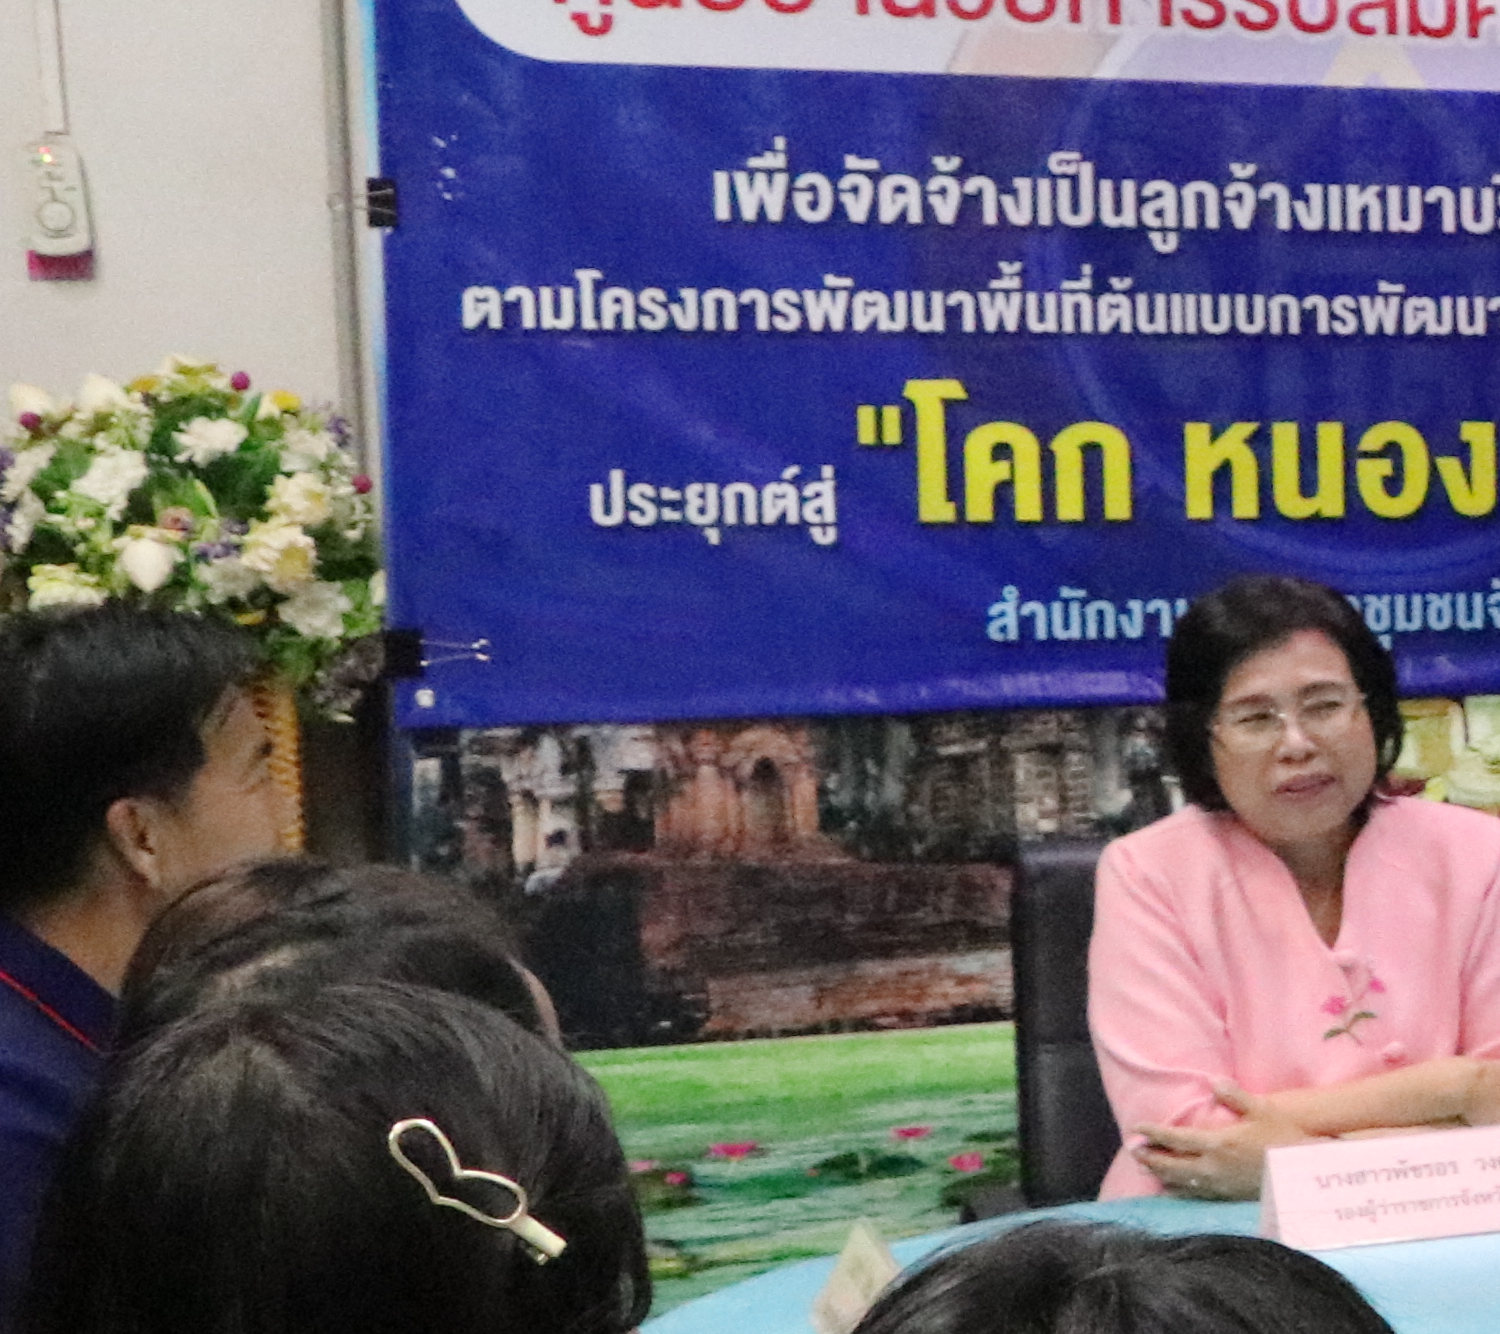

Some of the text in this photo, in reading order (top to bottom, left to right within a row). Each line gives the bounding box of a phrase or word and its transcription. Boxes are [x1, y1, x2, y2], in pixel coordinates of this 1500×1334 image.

[589, 463, 838, 546] ประยุกต์สู่
[856, 378, 1133, 524] "โคก
[1183, 420, 1498, 520] หนอง
